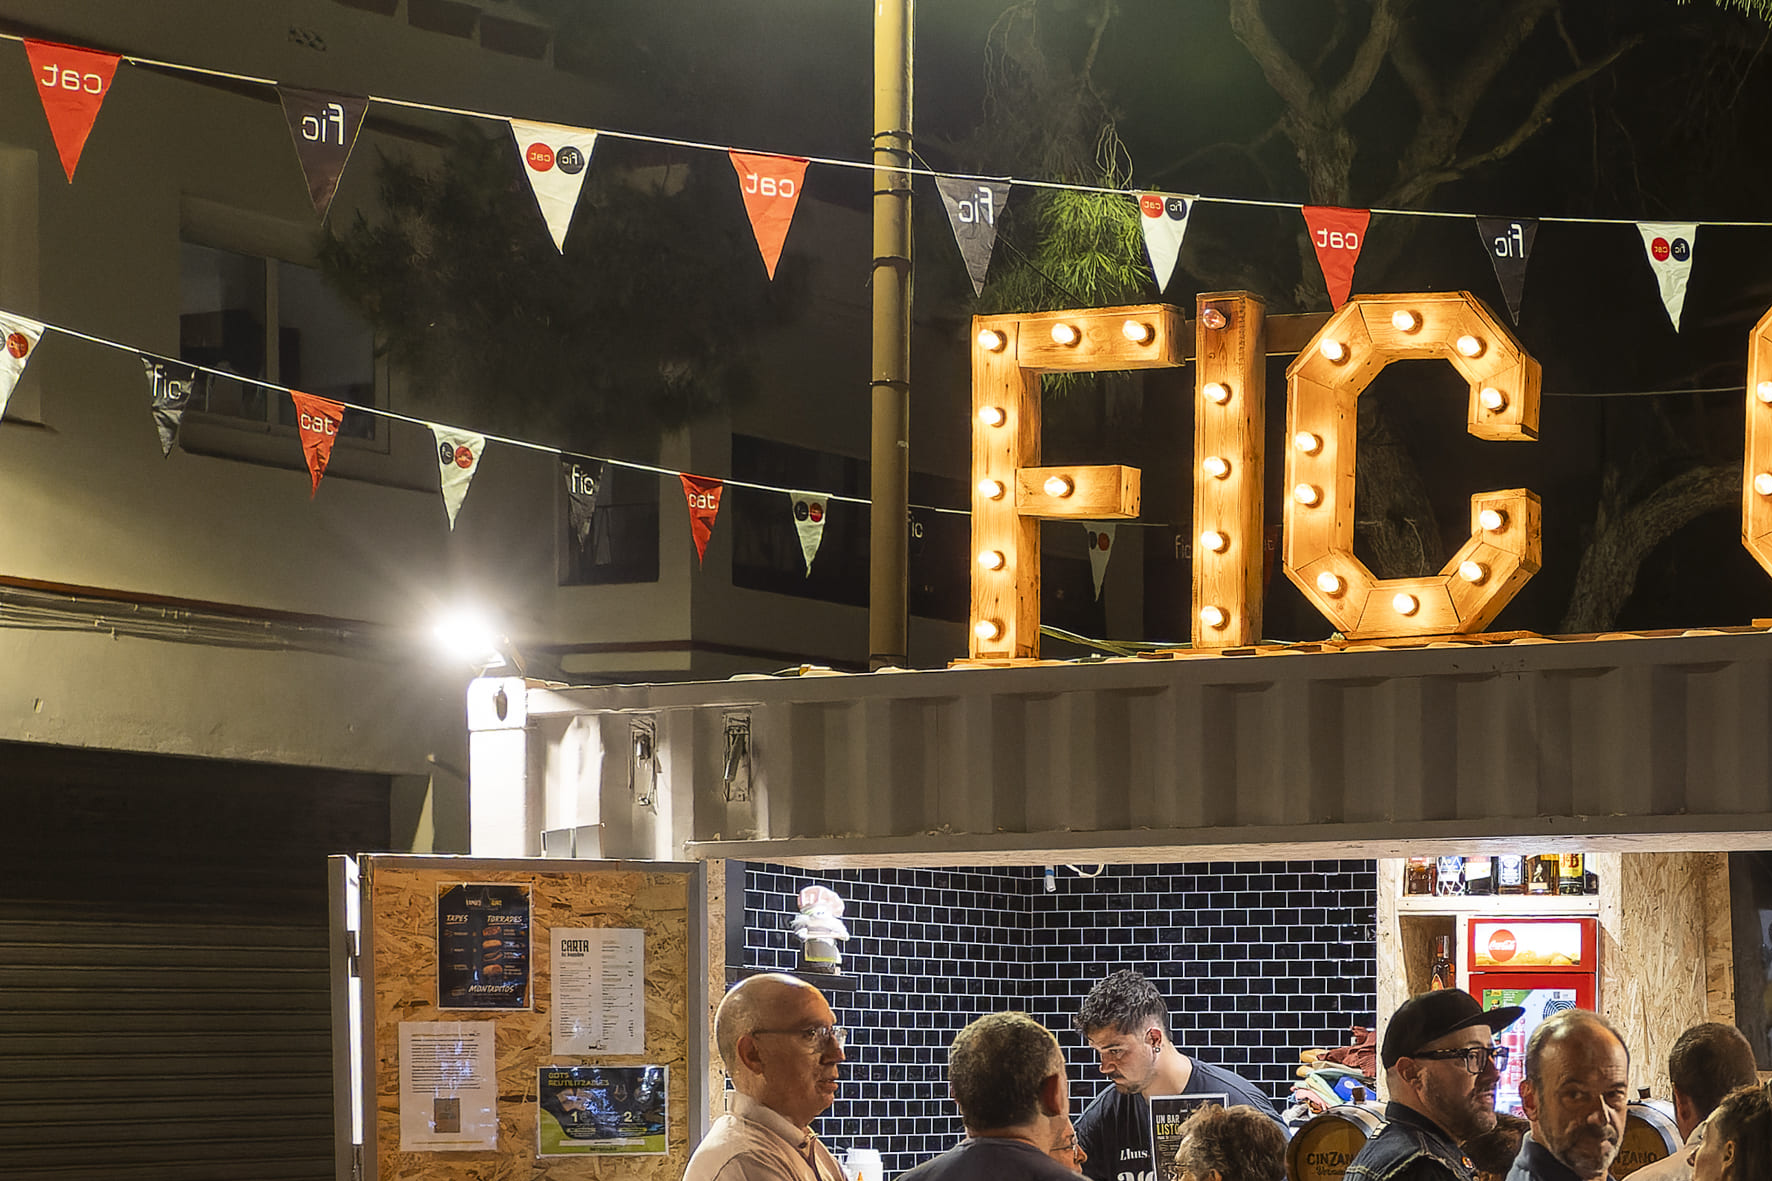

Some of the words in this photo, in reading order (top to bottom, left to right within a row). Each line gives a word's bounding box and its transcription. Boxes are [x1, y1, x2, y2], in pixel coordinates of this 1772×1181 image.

[152, 363, 182, 400] fic
[300, 412, 335, 436] cat
[571, 463, 595, 496] fic
[970, 290, 1543, 660] FIC
[688, 492, 716, 509] cat
[561, 939, 590, 953] CARTA
[1306, 1151, 1354, 1167] CINZAN
